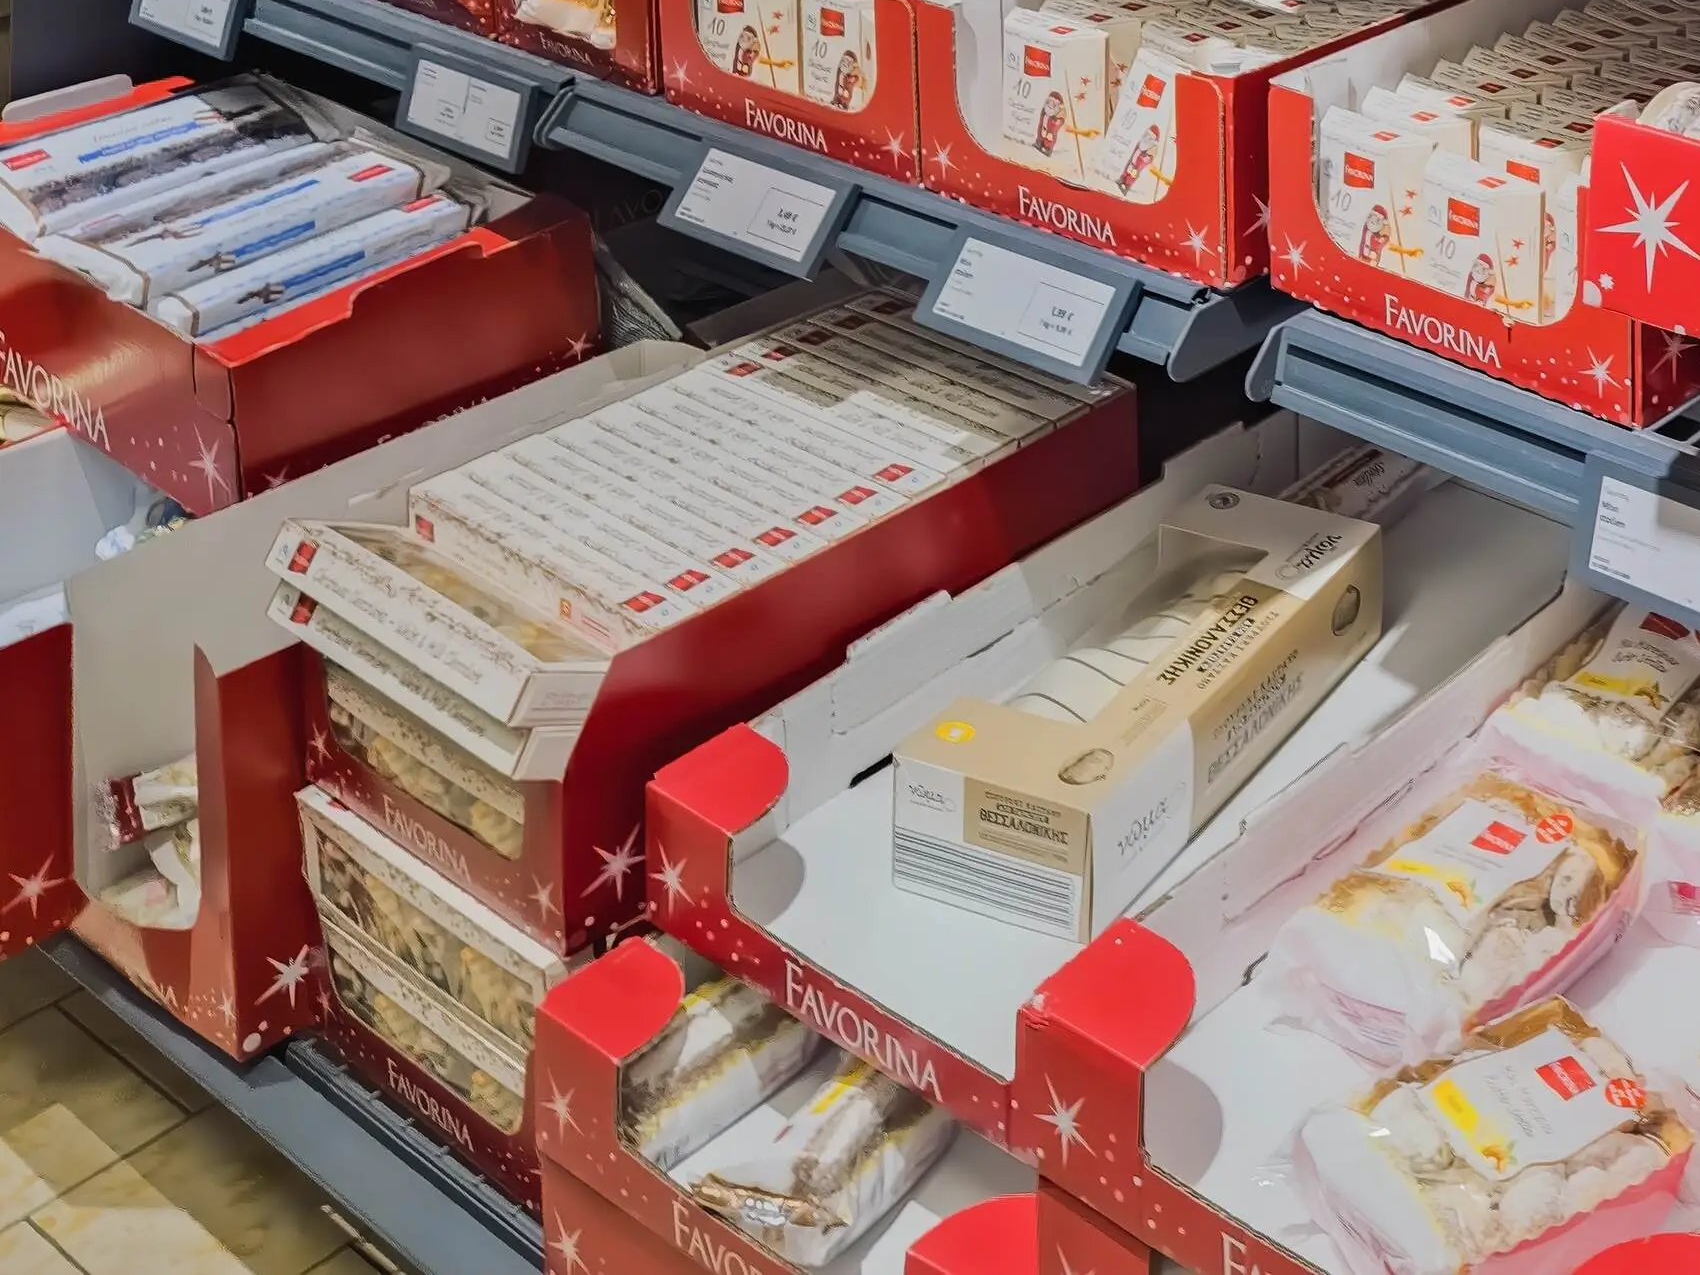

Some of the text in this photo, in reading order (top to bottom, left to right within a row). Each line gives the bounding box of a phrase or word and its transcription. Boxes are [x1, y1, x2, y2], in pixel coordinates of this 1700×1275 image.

[744, 97, 829, 153] FAVORINA
[1017, 185, 1117, 247] FAVORINA
[1383, 292, 1503, 369] FAVORINA
[383, 794, 473, 887] FAVORINA
[785, 959, 944, 1104] FAVORINA
[387, 1057, 476, 1153] FAVORINA
